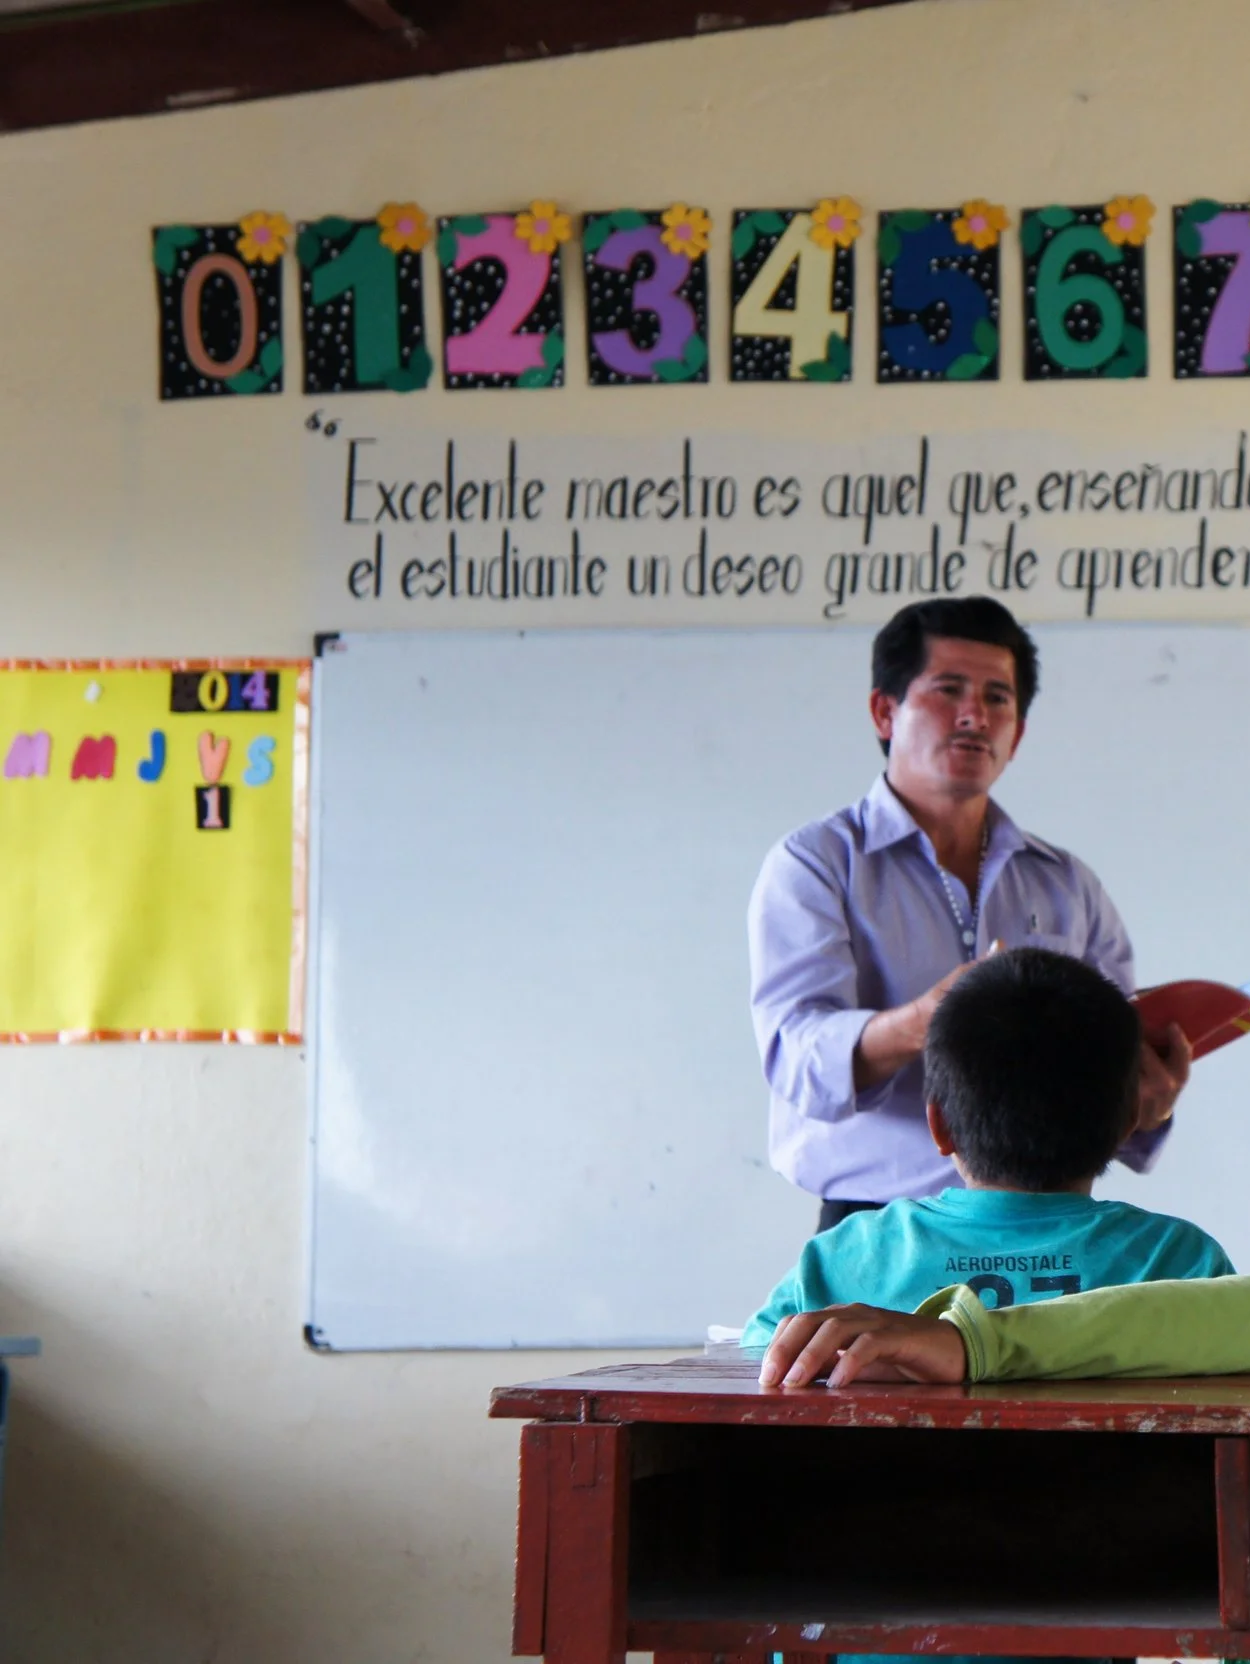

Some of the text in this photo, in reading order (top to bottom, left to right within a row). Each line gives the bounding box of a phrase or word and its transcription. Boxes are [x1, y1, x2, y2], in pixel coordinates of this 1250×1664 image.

[310, 226, 402, 384] 1
[447, 215, 558, 375] 2
[594, 226, 698, 376] 3
[734, 212, 848, 378] 4
[883, 220, 997, 372] 5
[1036, 226, 1124, 368] 6
[566, 438, 736, 520] maestro
[754, 475, 801, 519] es
[821, 435, 928, 546] aquel
[948, 471, 1028, 546] que,
[347, 531, 383, 600] el
[401, 527, 607, 600] estudiante
[628, 554, 671, 599] un
[683, 525, 801, 598] deseo
[823, 522, 966, 620] grande
[988, 521, 1038, 591] de
[137, 730, 166, 782] J
[243, 735, 276, 786] S
[945, 1254, 1073, 1273] AEROPOSTALE
